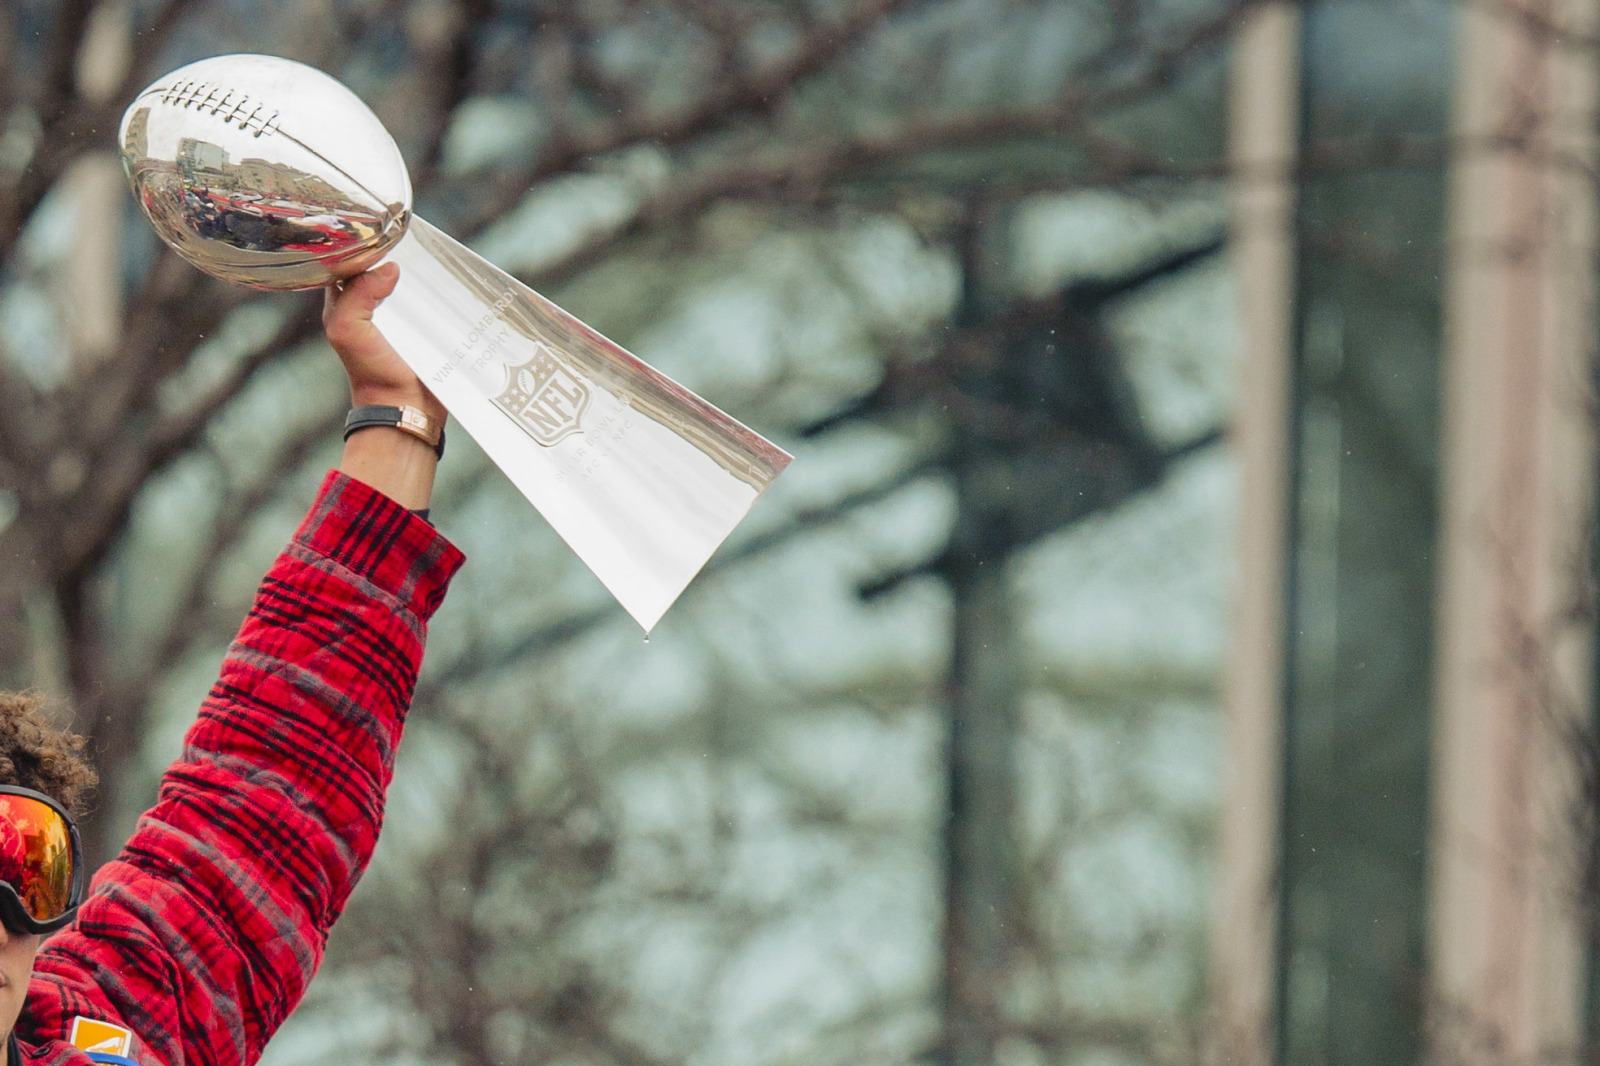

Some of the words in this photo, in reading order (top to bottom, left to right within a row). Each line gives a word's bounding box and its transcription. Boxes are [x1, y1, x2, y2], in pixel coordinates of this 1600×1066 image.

[432, 348, 465, 383] VINCE
[470, 327, 510, 374] TROPHY
[523, 378, 583, 435] NFL
